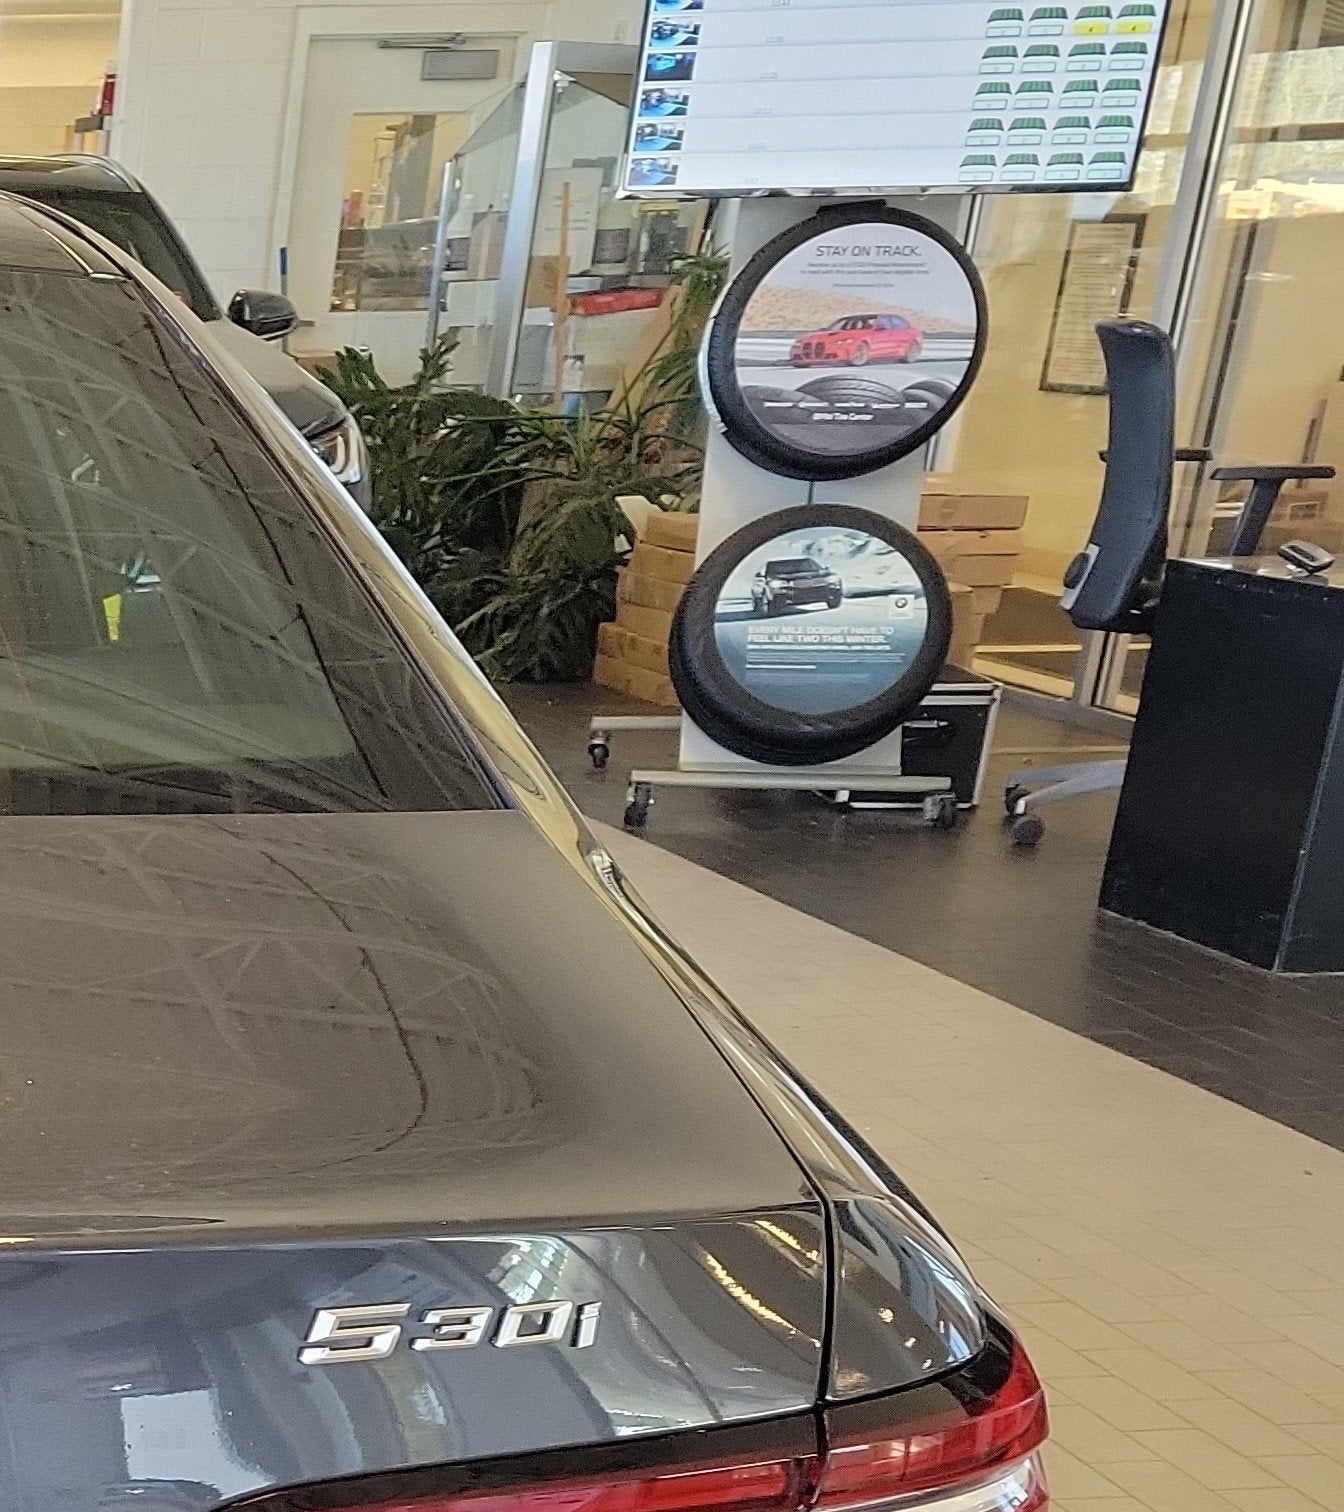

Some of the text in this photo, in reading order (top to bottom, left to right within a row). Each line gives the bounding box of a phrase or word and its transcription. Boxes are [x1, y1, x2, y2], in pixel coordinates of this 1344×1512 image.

[814, 245, 923, 257] STAY ON TRACK.
[881, 627, 894, 635] TO
[747, 634, 774, 643] FEEL
[775, 634, 798, 643] LIKE
[798, 634, 820, 643] TWO
[821, 634, 844, 643] THIS
[297, 1300, 603, 1365] 530i
